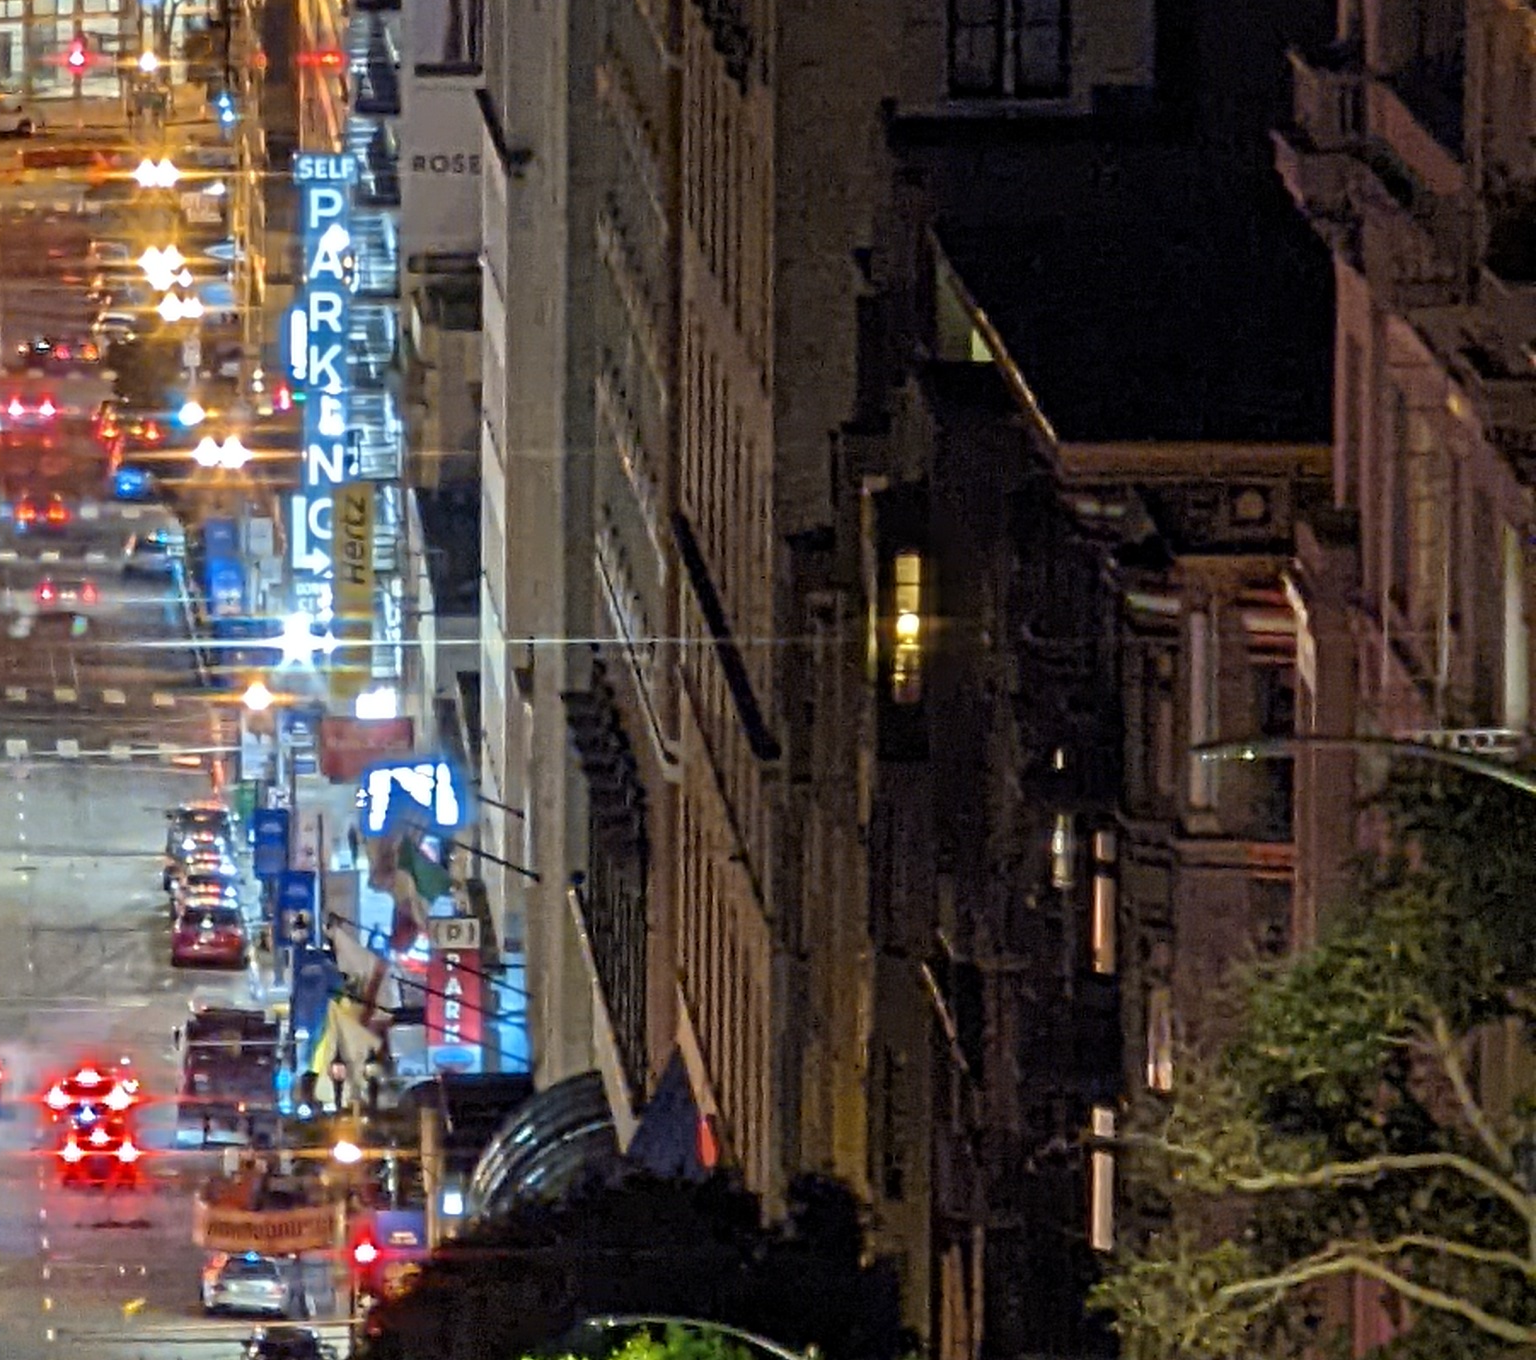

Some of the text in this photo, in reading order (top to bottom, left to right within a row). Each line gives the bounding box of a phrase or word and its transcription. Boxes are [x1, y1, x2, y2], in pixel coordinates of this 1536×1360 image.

[298, 158, 356, 179] SELF
[309, 188, 345, 540] PARKING
[342, 494, 366, 585] Hertz
[444, 953, 463, 1044] PARK
